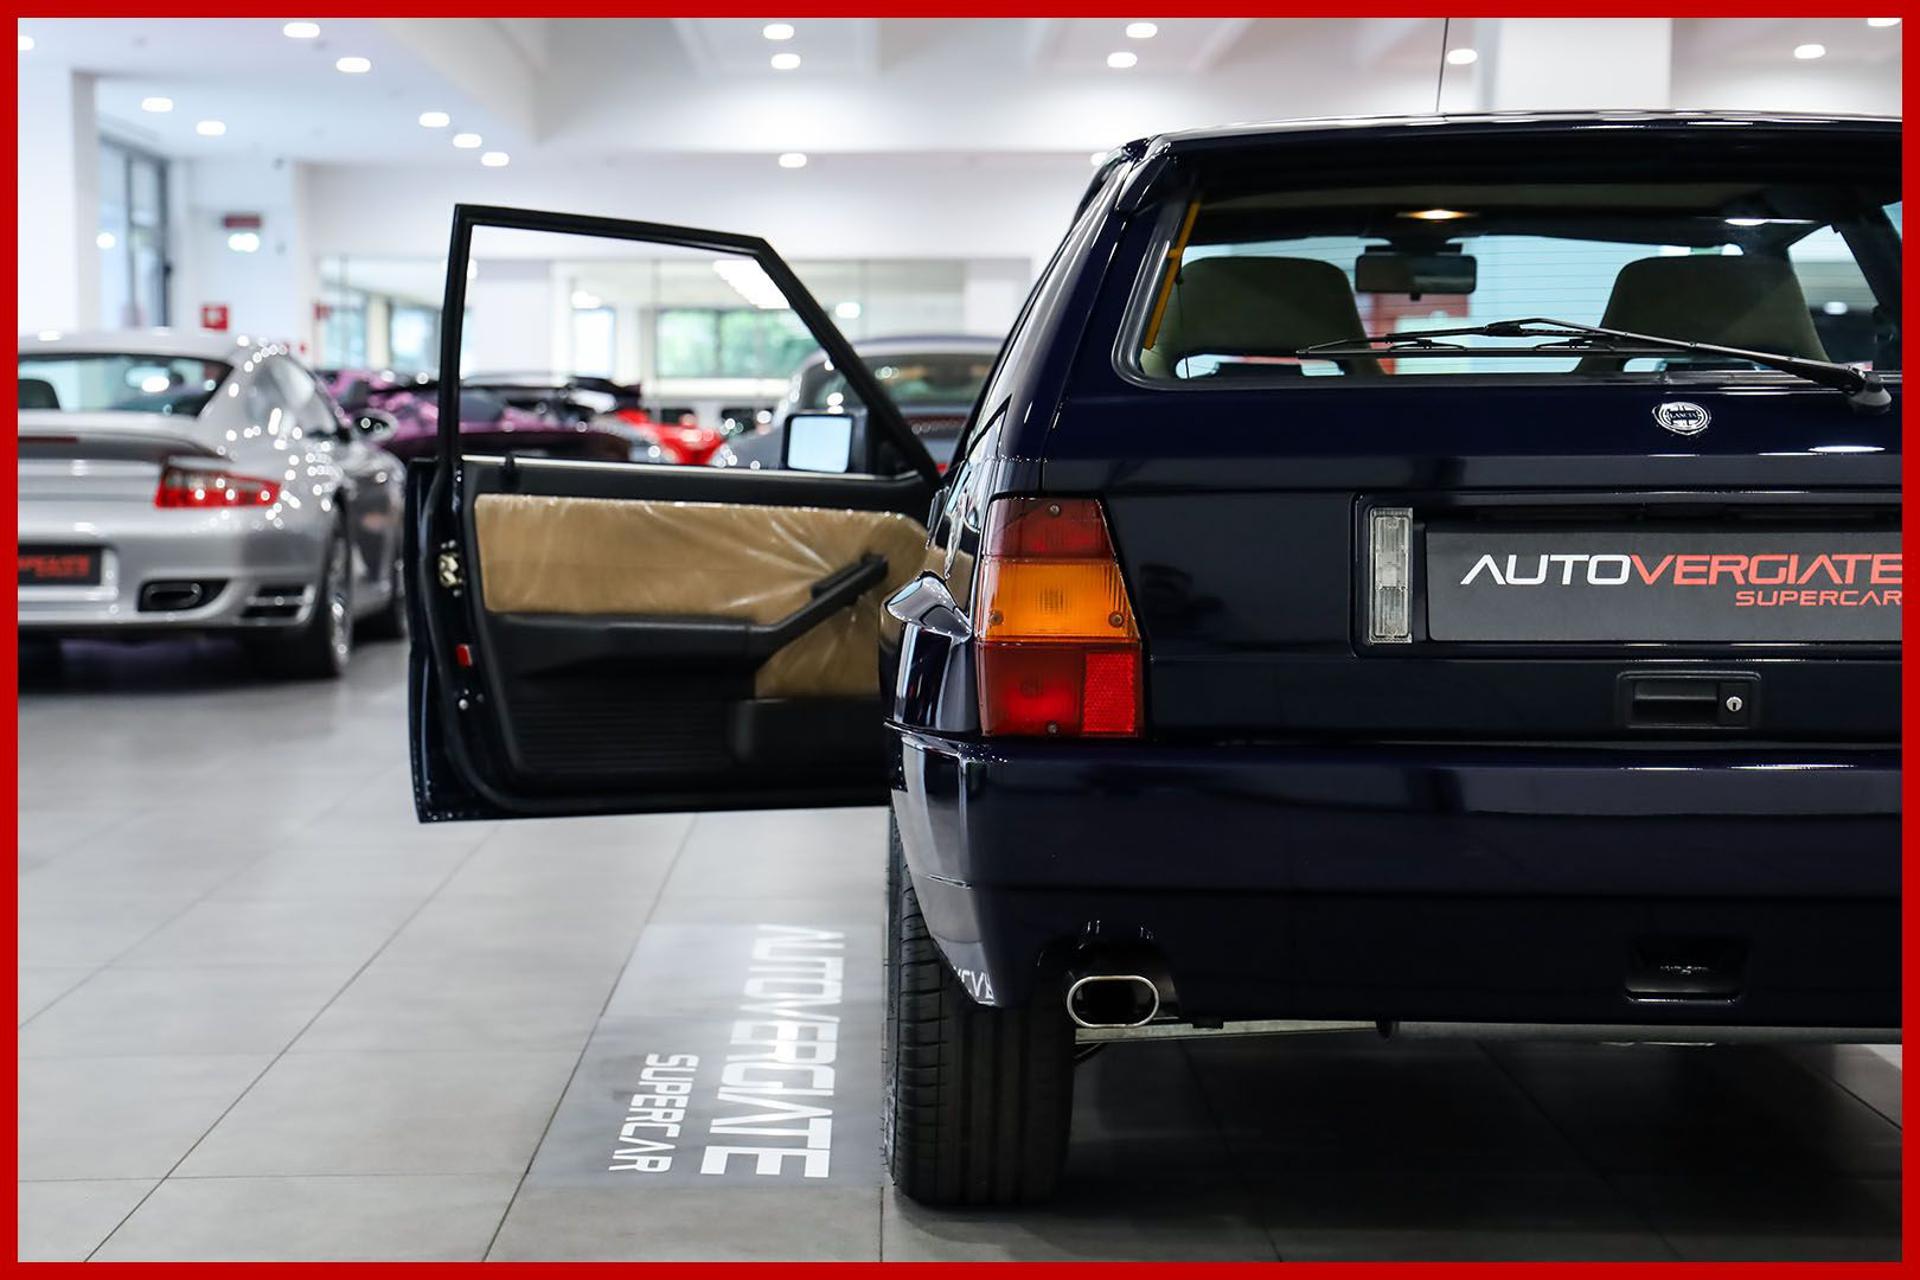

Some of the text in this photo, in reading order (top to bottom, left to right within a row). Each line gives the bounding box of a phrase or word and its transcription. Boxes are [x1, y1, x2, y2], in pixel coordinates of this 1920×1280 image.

[1460, 553, 1903, 585] AUTOVERGIATE
[1735, 590, 1902, 606] SUPERCAR
[700, 923, 845, 1178] AUTOVERGIATE
[608, 1053, 699, 1172] SUPERCAR
